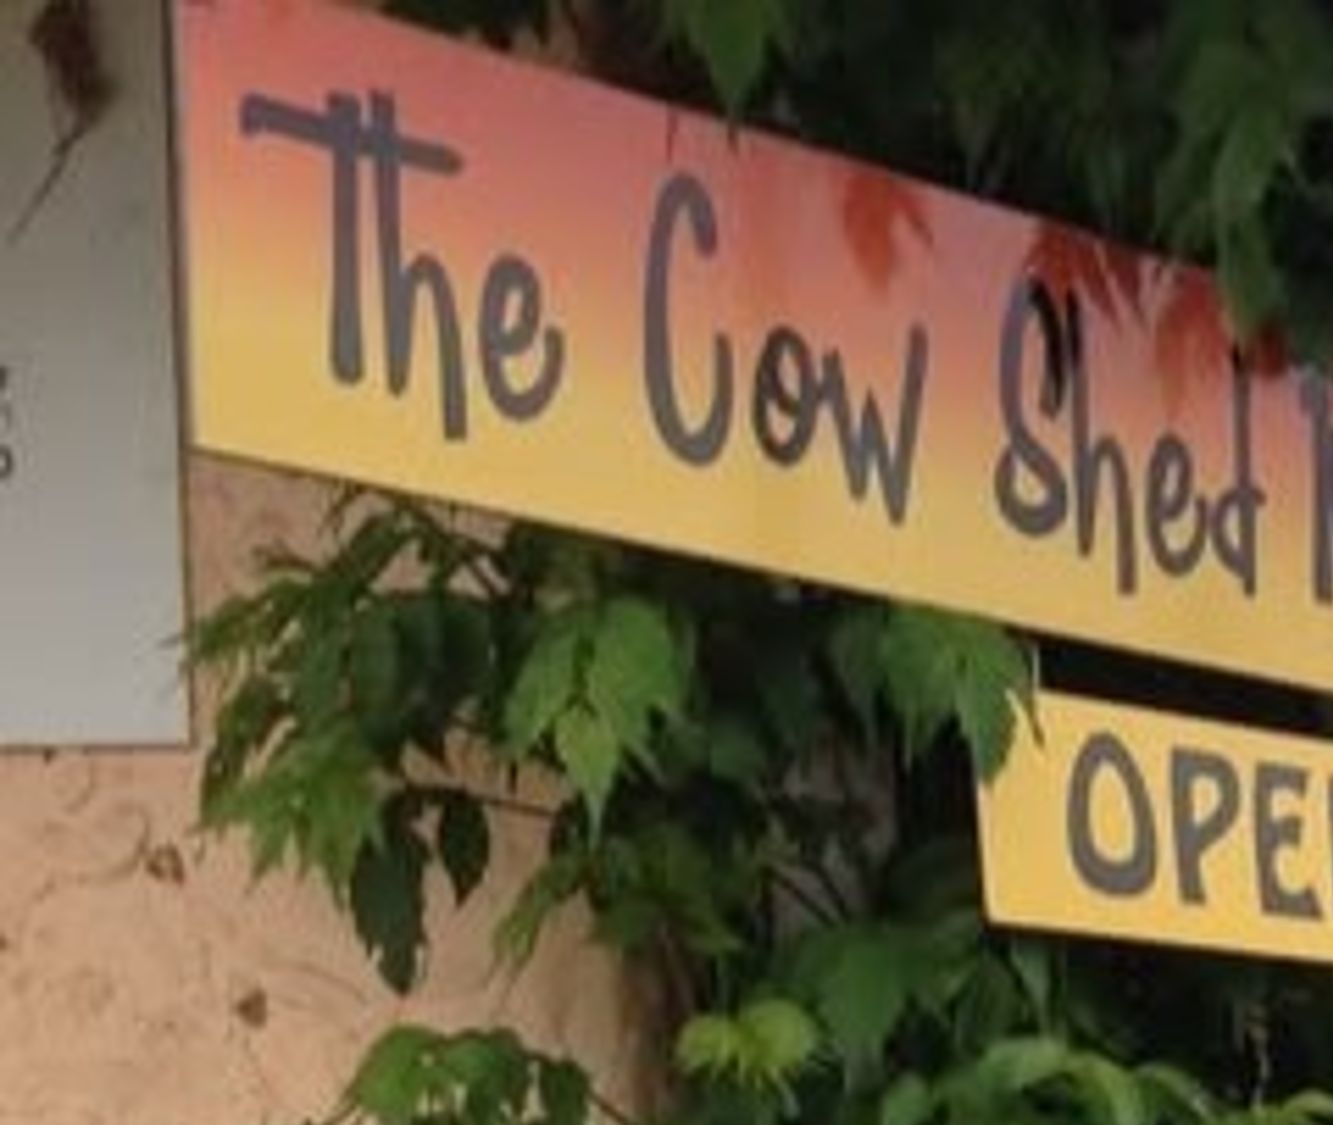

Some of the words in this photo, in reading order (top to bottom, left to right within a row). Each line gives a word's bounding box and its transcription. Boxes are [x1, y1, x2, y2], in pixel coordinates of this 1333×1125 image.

[238, 88, 565, 442] The
[643, 170, 930, 526] Cow
[992, 275, 1266, 598] Shed
